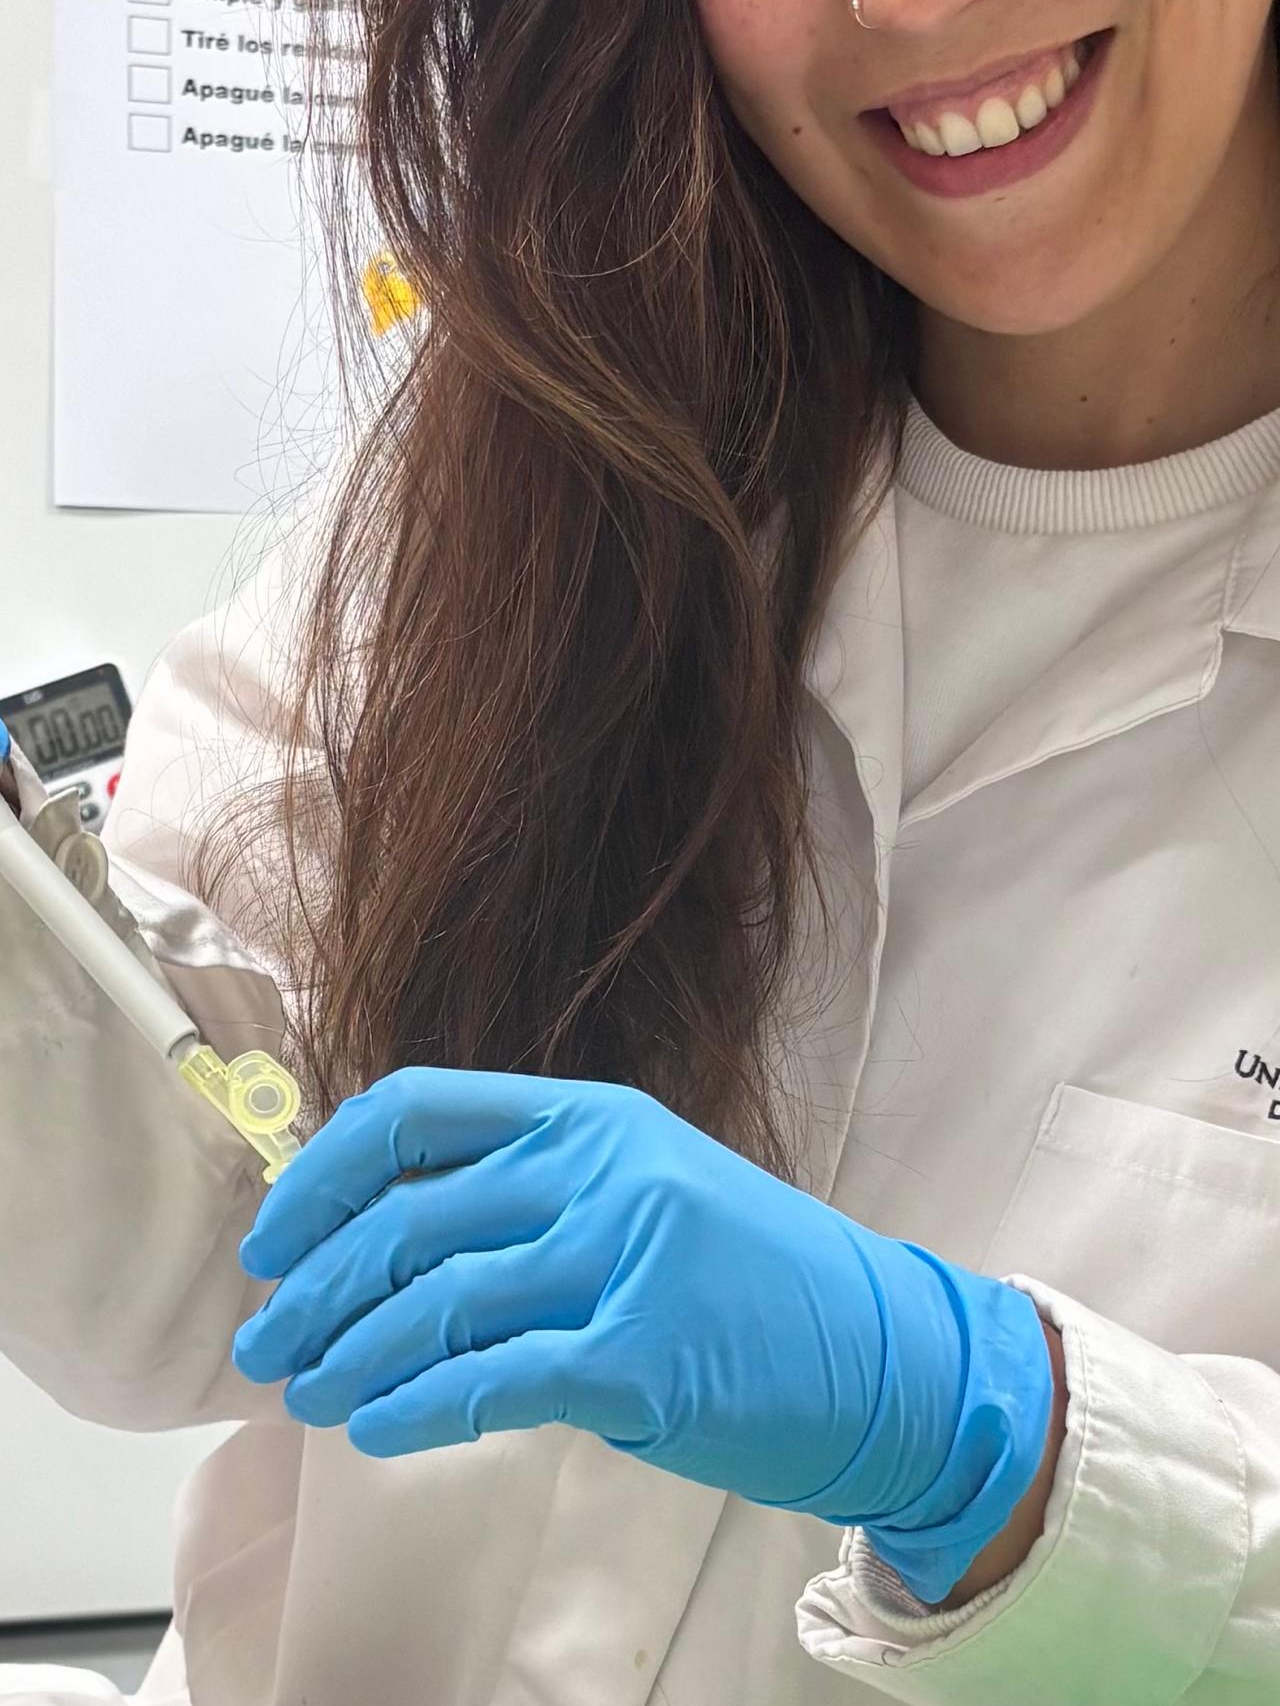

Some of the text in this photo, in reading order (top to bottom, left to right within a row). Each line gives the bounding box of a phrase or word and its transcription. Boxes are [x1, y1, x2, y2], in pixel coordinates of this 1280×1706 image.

[181, 30, 229, 51] Tiré
[238, 35, 273, 54] los
[181, 79, 275, 105] Apagué
[283, 87, 303, 104] la
[181, 127, 275, 153] Apagué
[283, 135, 304, 153] la
